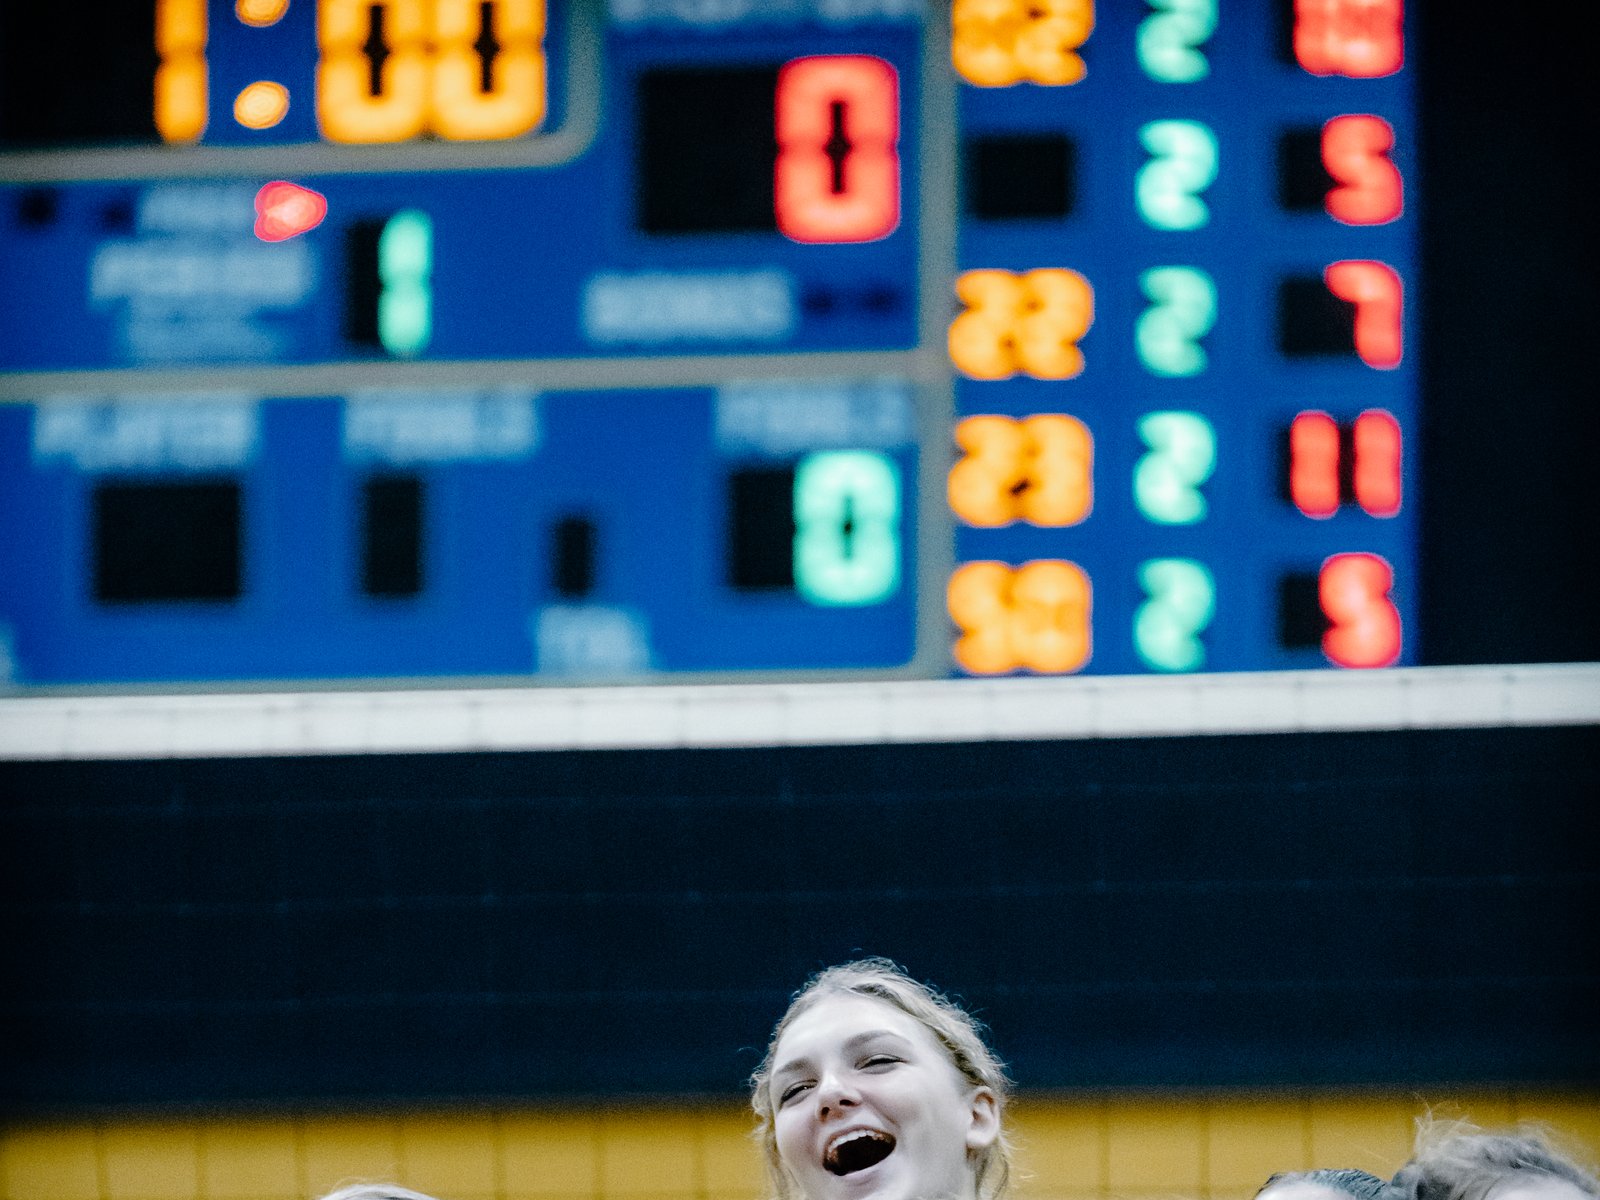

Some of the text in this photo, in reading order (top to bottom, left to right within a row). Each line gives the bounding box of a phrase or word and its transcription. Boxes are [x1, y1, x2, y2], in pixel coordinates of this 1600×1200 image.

[777, 57, 899, 243] 0
[1136, 115, 1402, 230] 2 5
[1137, 267, 1216, 376] 2
[1328, 261, 1402, 367] 7
[1134, 411, 1216, 524] 2
[1292, 412, 1401, 516] 11
[795, 449, 900, 606] 0
[1134, 558, 1215, 674] 2
[1320, 553, 1401, 668] 5
